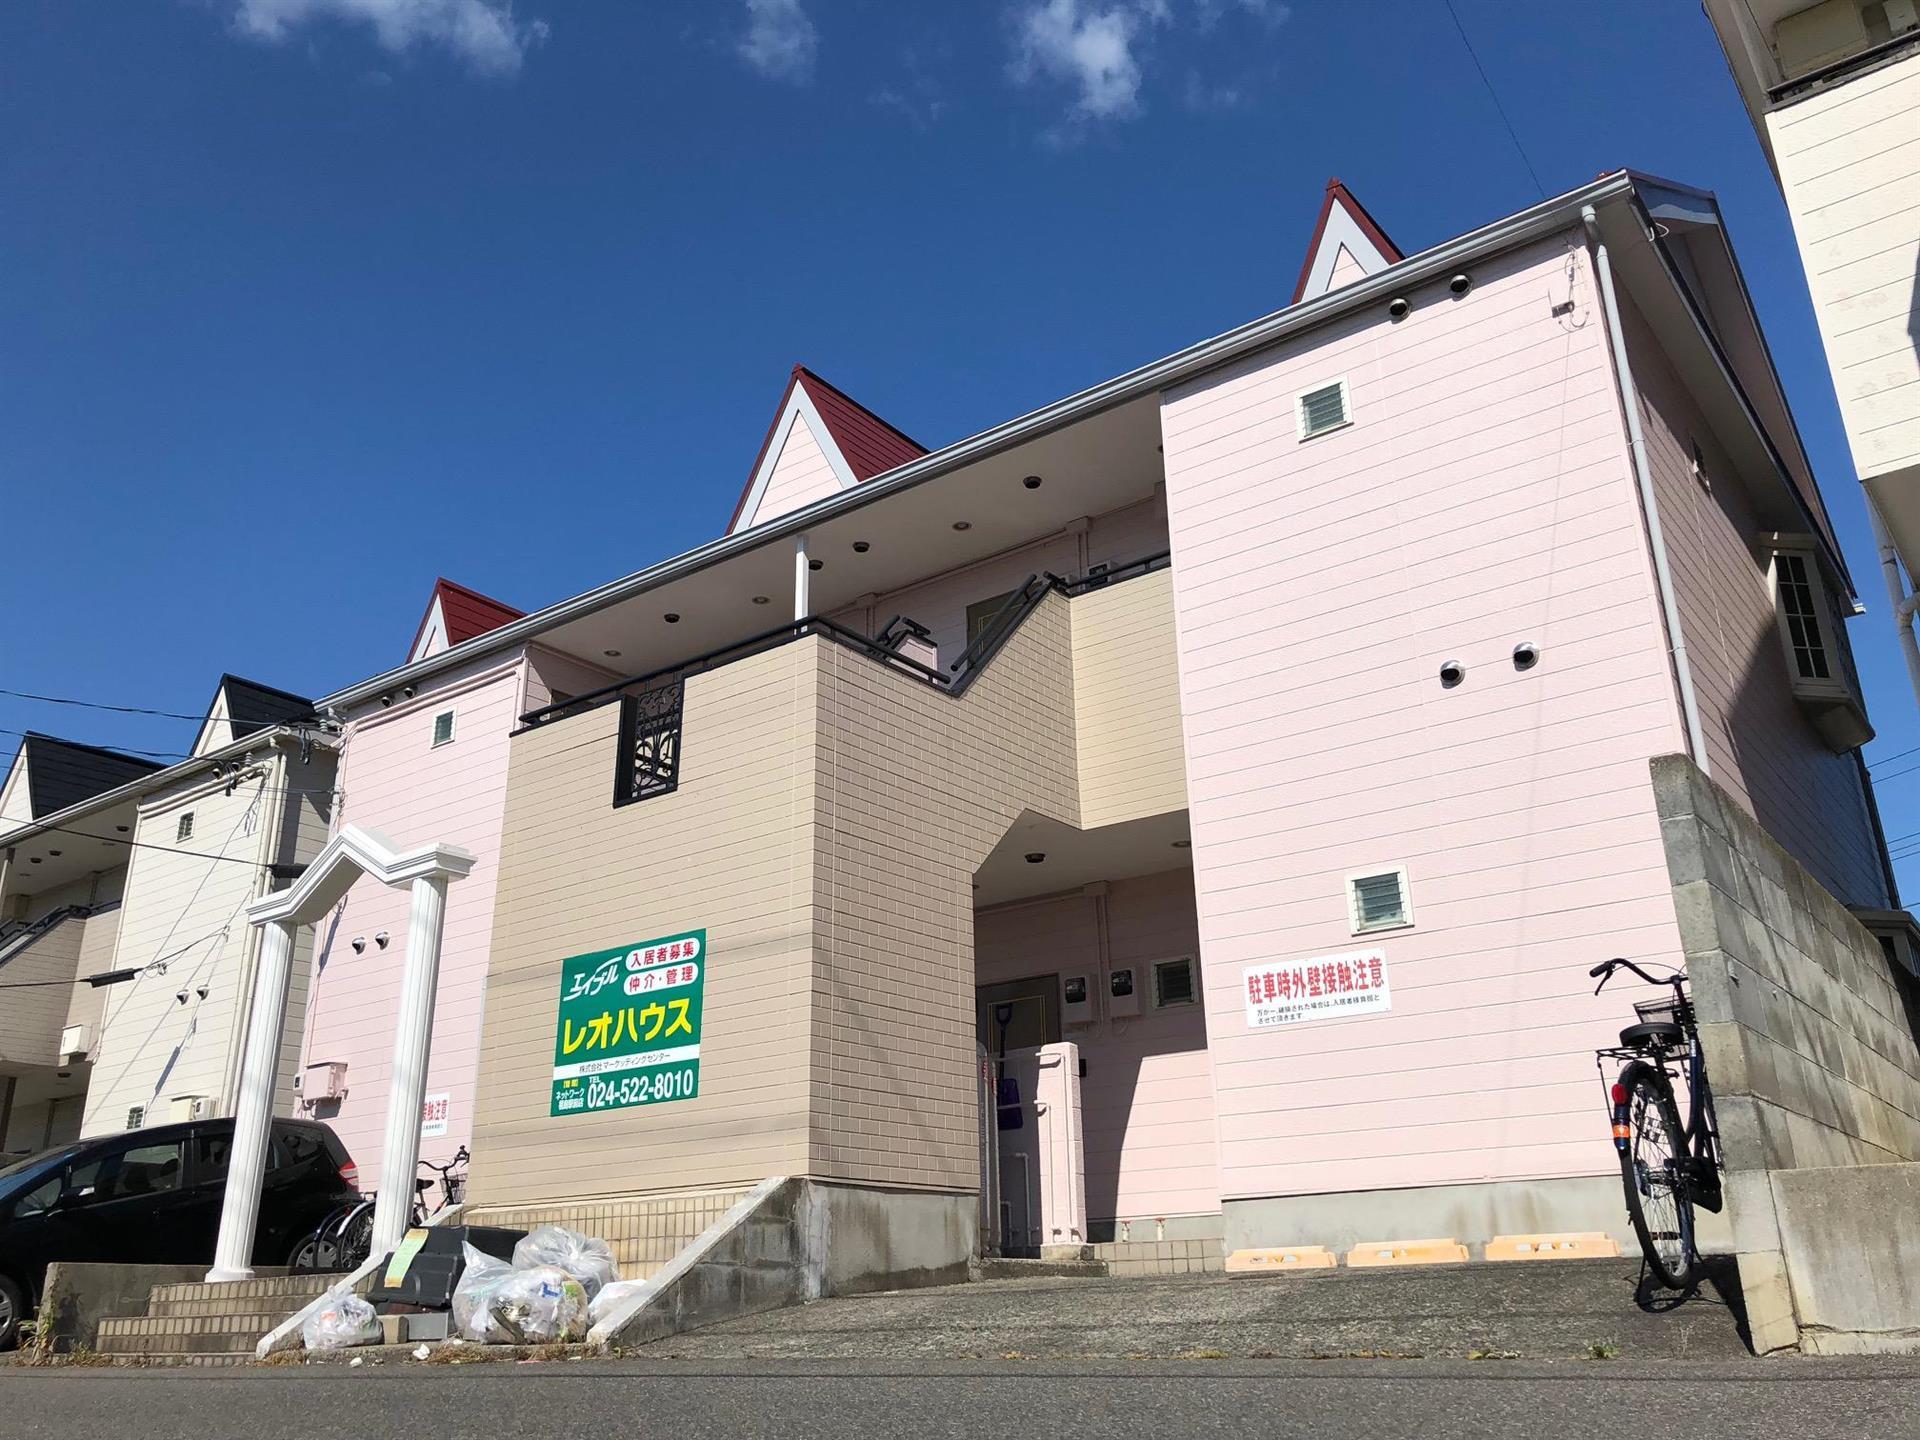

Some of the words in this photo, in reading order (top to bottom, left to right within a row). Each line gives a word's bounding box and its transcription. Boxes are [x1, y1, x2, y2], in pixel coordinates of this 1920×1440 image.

[631, 941, 694, 968] 入居者募集
[563, 956, 623, 1001] エイブル
[629, 966, 694, 992] 仲介・管理
[1248, 956, 1384, 1005] 駐車時外壁接触注意
[563, 998, 692, 1054] レオハウス
[587, 1069, 693, 1109] 024-522-8010
